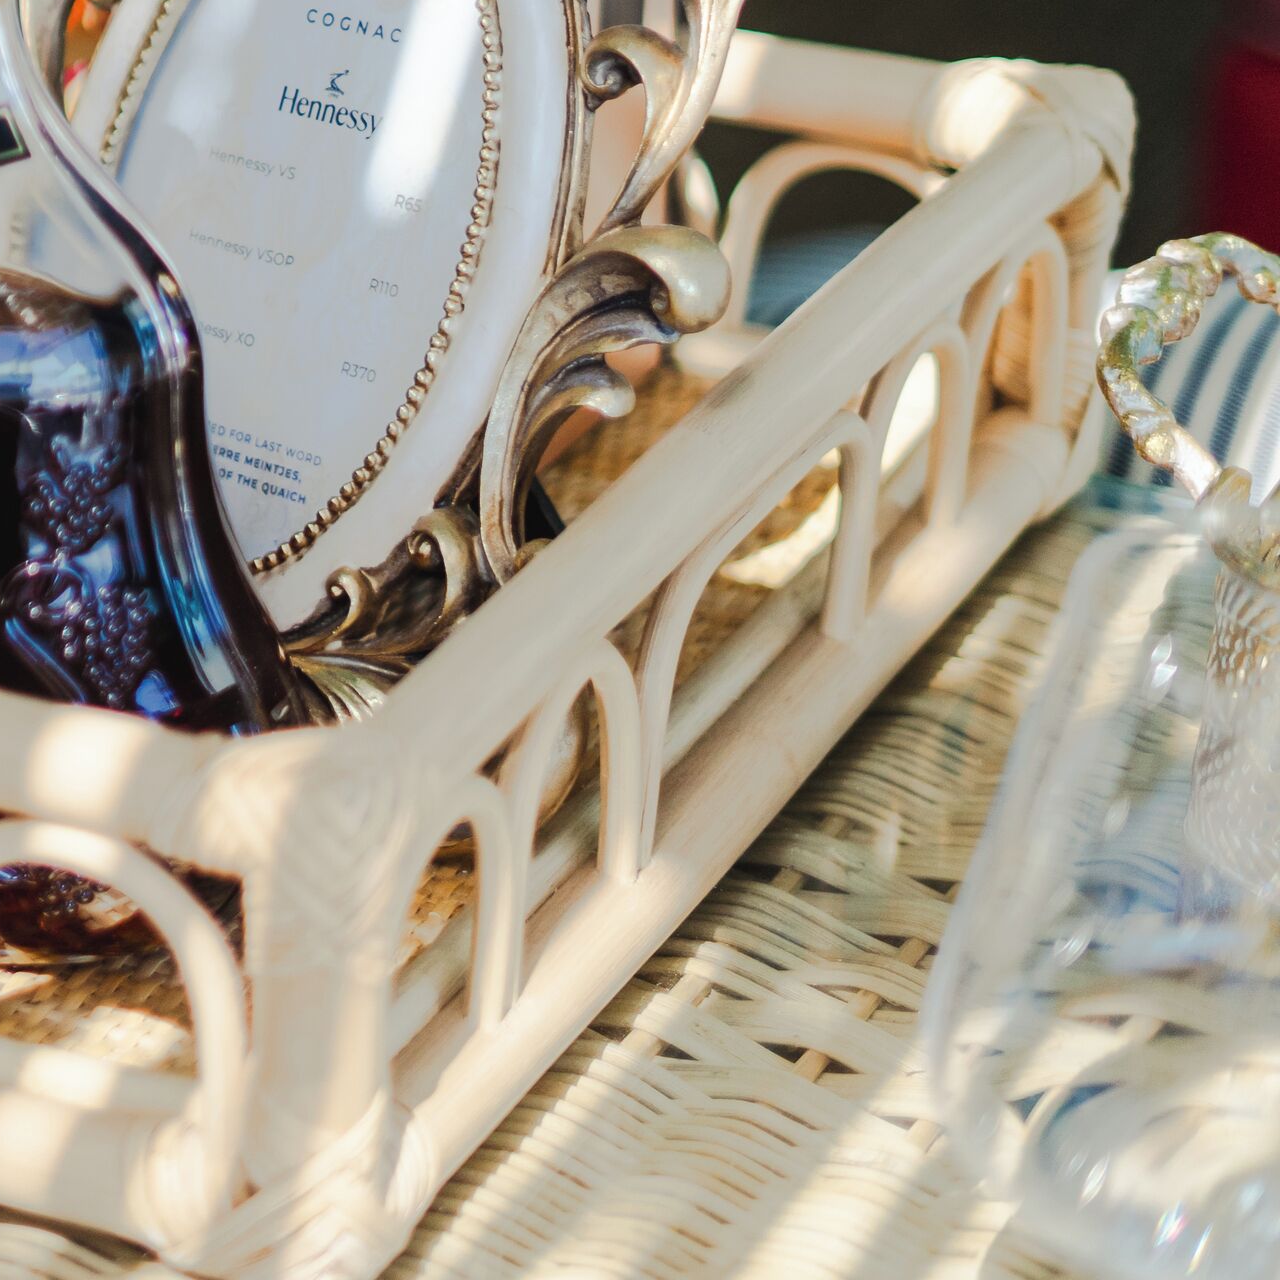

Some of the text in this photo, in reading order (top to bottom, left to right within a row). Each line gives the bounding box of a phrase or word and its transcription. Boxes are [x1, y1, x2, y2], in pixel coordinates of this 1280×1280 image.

[306, 8, 403, 44] COGNAC
[277, 85, 383, 140] Hennessy
[209, 145, 423, 214] Hennessy VS R65
[229, 429, 252, 444] FOR
[255, 437, 283, 453] LAST
[285, 447, 322, 466] WORD
[218, 468, 306, 505] OF THE QUAICH
